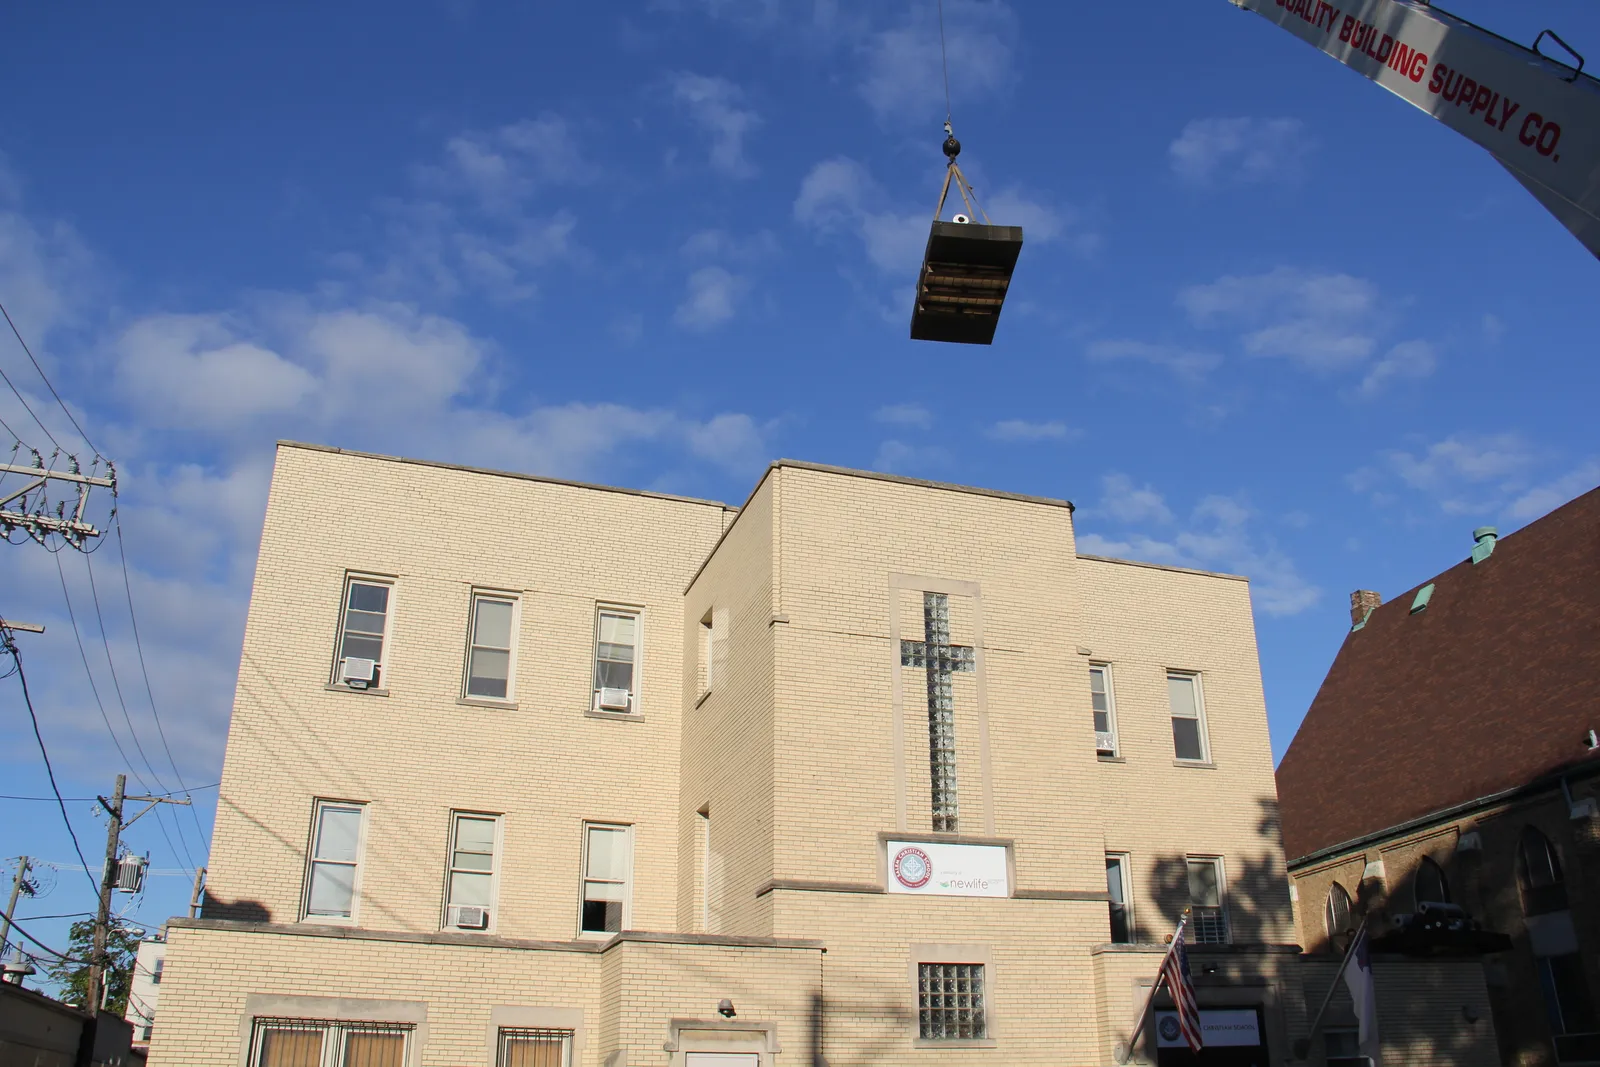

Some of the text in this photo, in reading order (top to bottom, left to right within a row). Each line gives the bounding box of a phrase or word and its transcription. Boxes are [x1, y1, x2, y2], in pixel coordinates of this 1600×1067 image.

[1338, 14, 1429, 83] BUILDING
[1427, 63, 1520, 132] SUPPLY
[1517, 112, 1562, 163] CO.
[898, 849, 924, 859] CHRISTIAN
[950, 878, 989, 890] newlife
